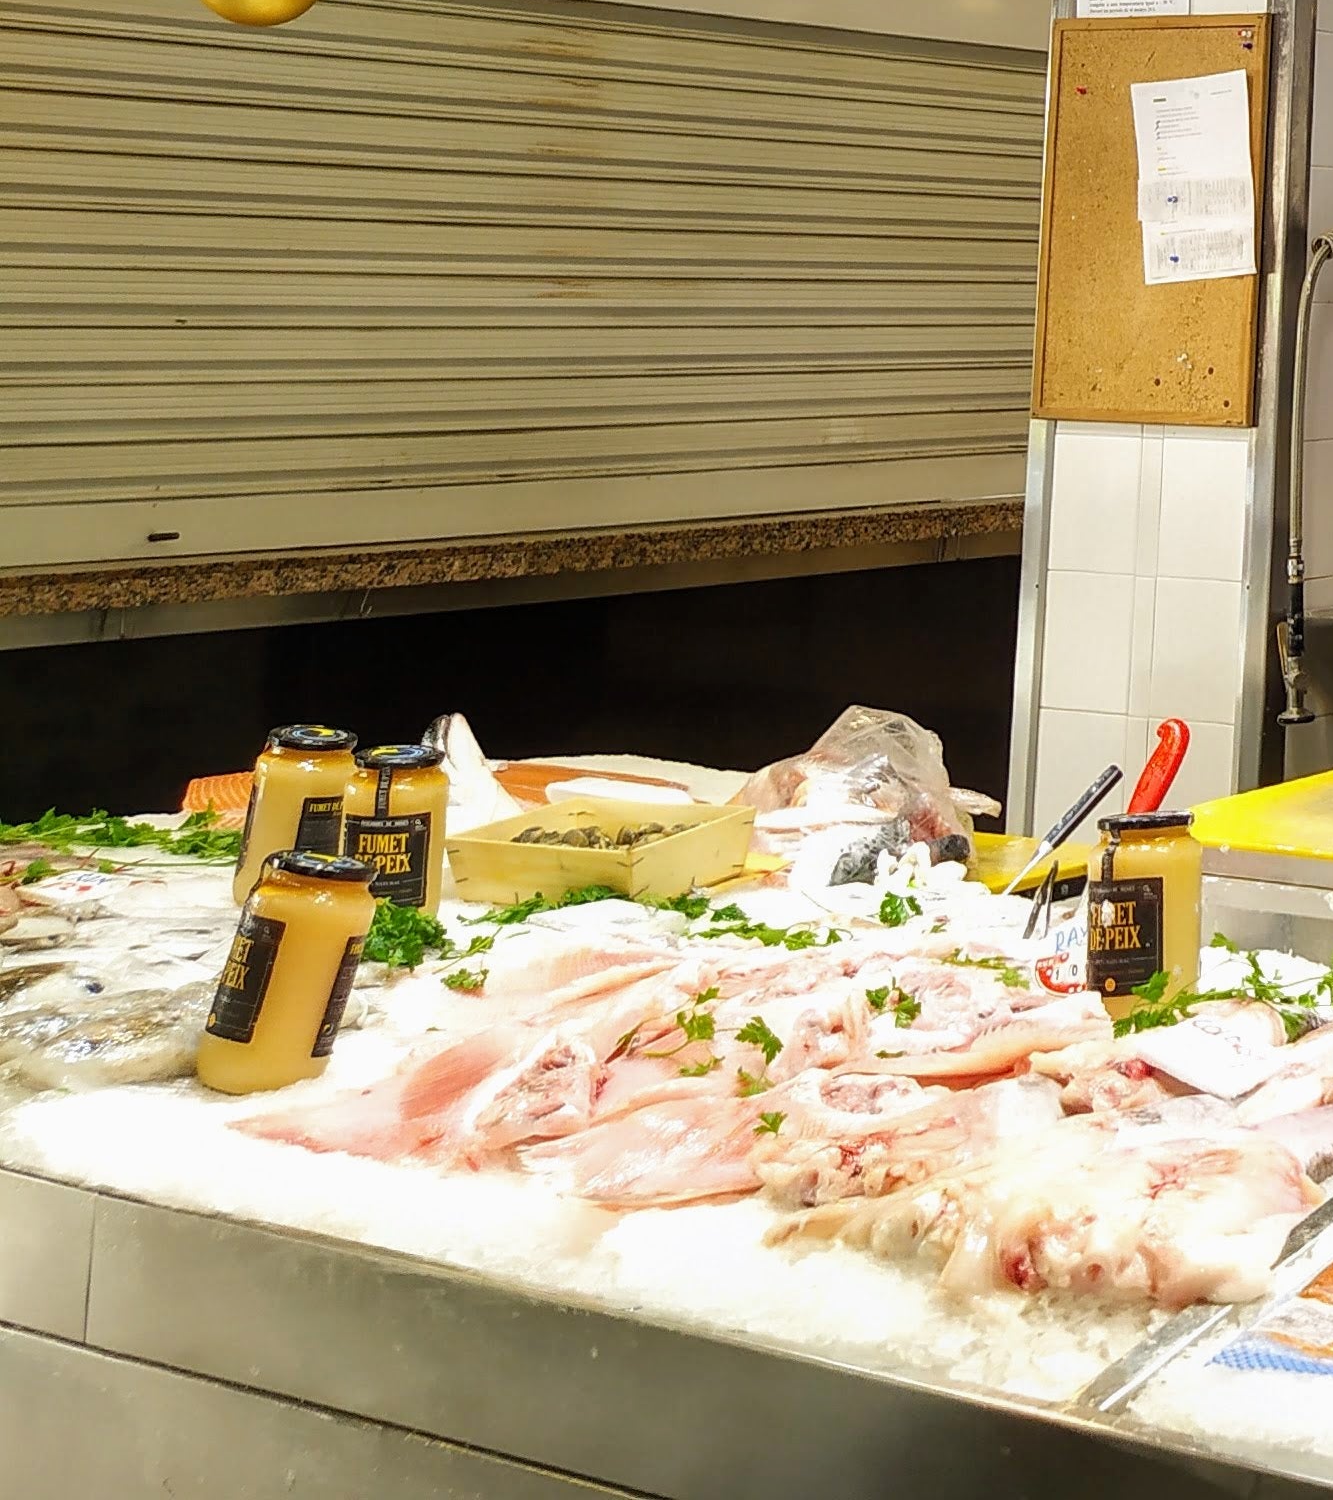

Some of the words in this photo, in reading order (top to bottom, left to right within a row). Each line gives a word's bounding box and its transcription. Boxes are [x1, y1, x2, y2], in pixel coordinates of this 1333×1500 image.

[358, 833, 410, 853] FUMET
[374, 852, 412, 875] PEIX
[1090, 928, 1104, 951] DE
[1105, 925, 1142, 950] PEIX
